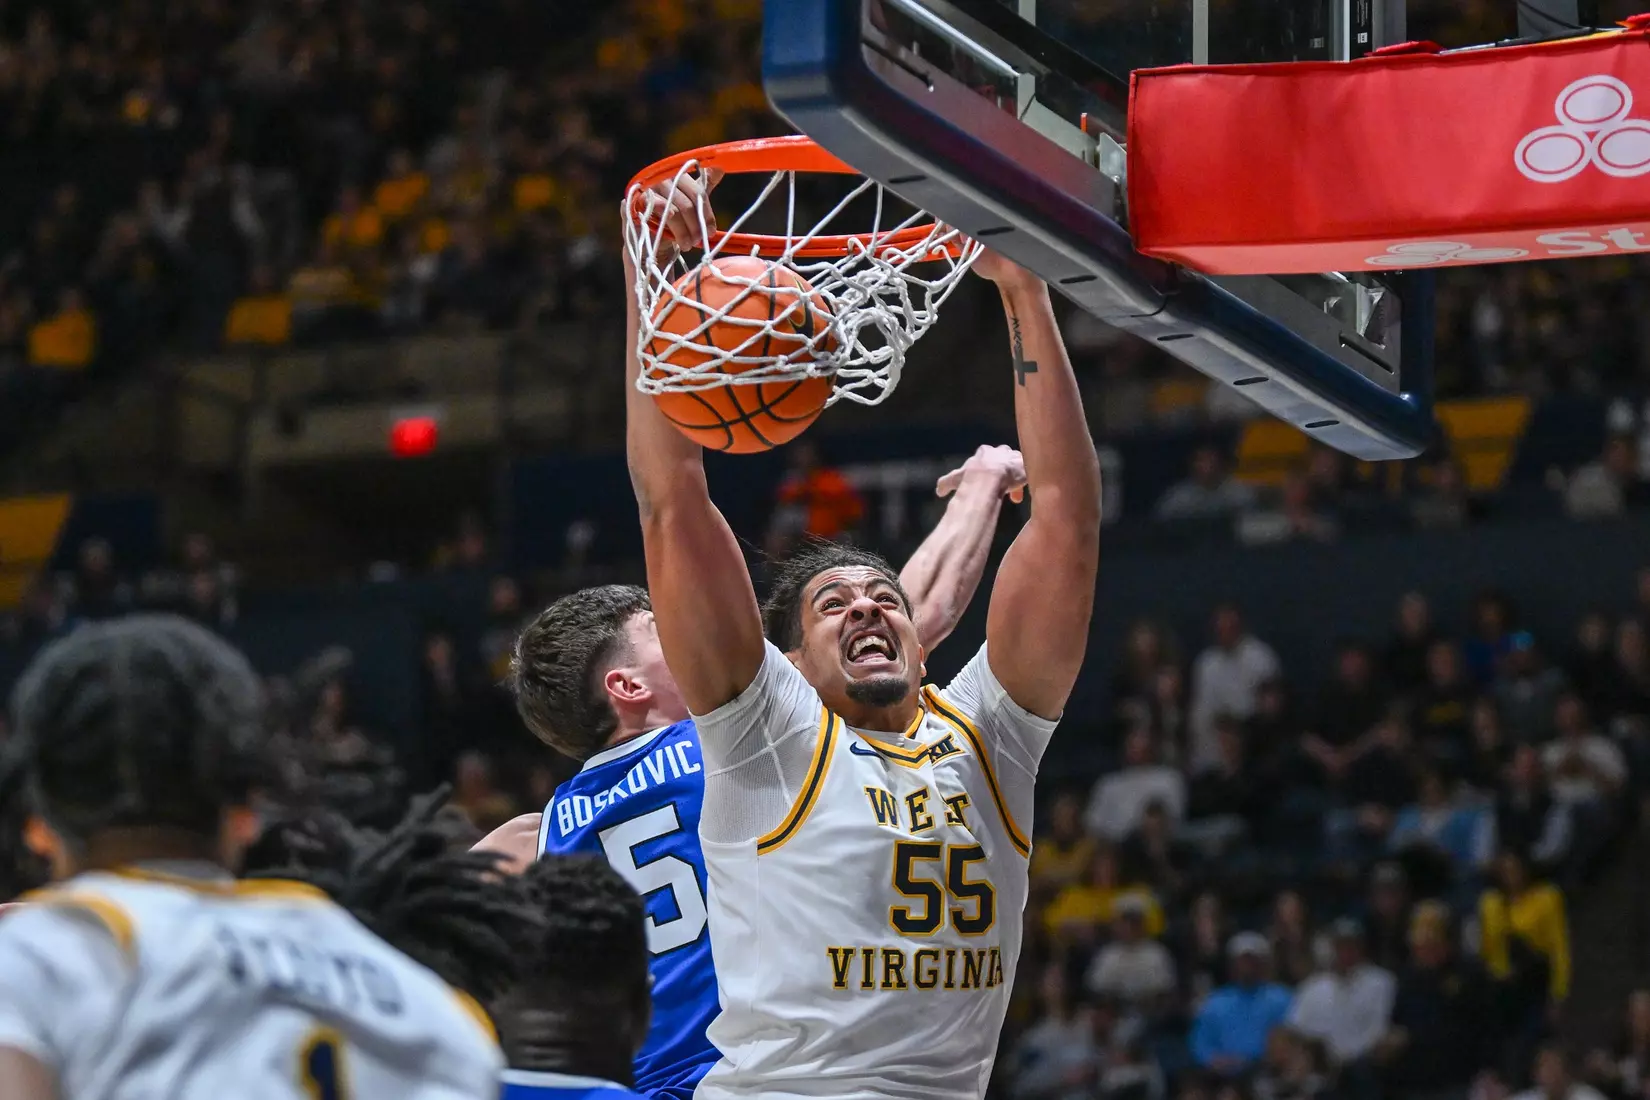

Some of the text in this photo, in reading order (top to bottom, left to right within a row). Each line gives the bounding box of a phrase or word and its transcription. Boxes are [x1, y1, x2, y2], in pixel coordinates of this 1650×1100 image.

[556, 740, 701, 838] BOSKOVIC
[597, 800, 709, 957] 5
[888, 839, 997, 937] 55
